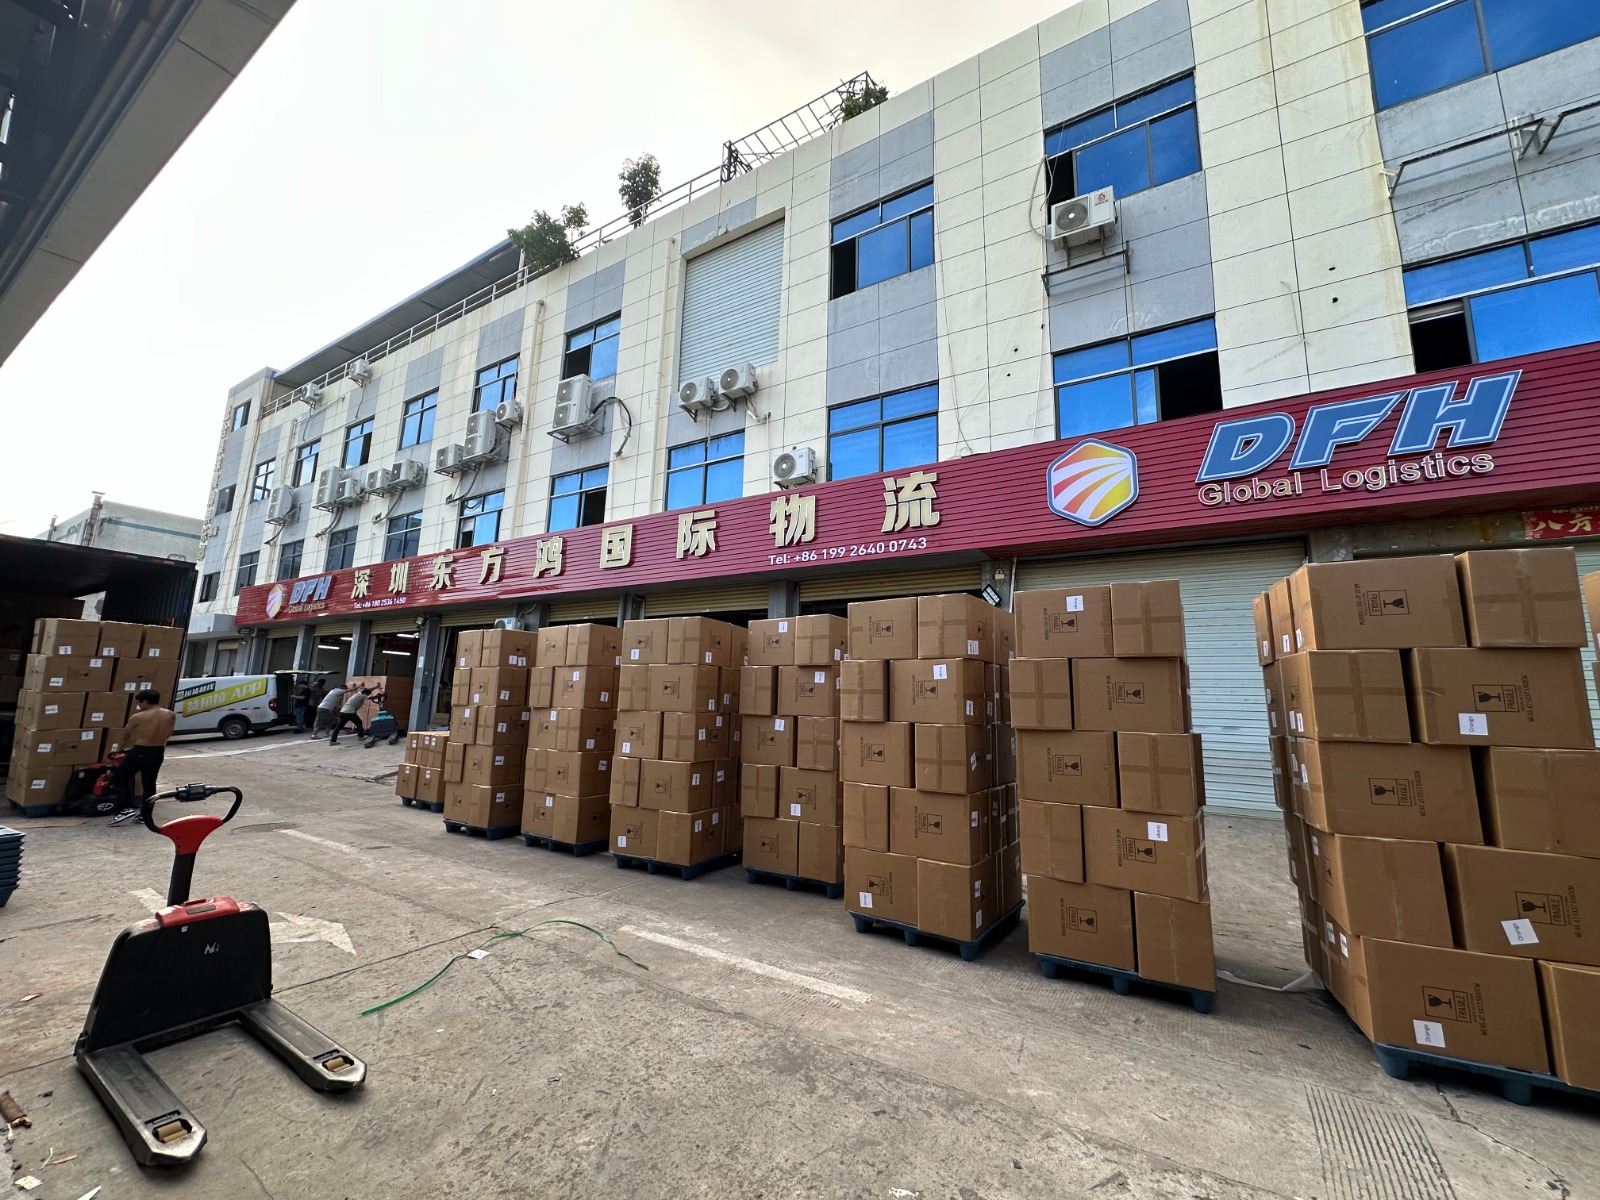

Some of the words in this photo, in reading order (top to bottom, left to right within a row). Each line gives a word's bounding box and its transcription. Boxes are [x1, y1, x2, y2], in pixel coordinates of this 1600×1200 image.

[1195, 369, 1523, 483] DFH
[1198, 471, 1303, 506] Global
[1321, 453, 1495, 491] Logistics
[350, 471, 940, 600] 深圳东方鸿国际物流
[768, 554, 791, 565] Tel:
[793, 550, 818, 562] +86
[821, 547, 845, 559] 199
[849, 542, 885, 556] 2640
[889, 537, 927, 552] 0743
[289, 576, 332, 604] DFH
[288, 603, 303, 614] Global
[304, 602, 325, 612] Logistics
[1370, 593, 1380, 614] FRAGILE
[231, 681, 262, 700] APP
[1505, 688, 1516, 709] FRAGILE
[1399, 783, 1408, 803] FRAGILE
[1552, 899, 1562, 922] FRAGILE
[1512, 923, 1523, 941] Orange
[1456, 995, 1467, 1019] FRAGILE
